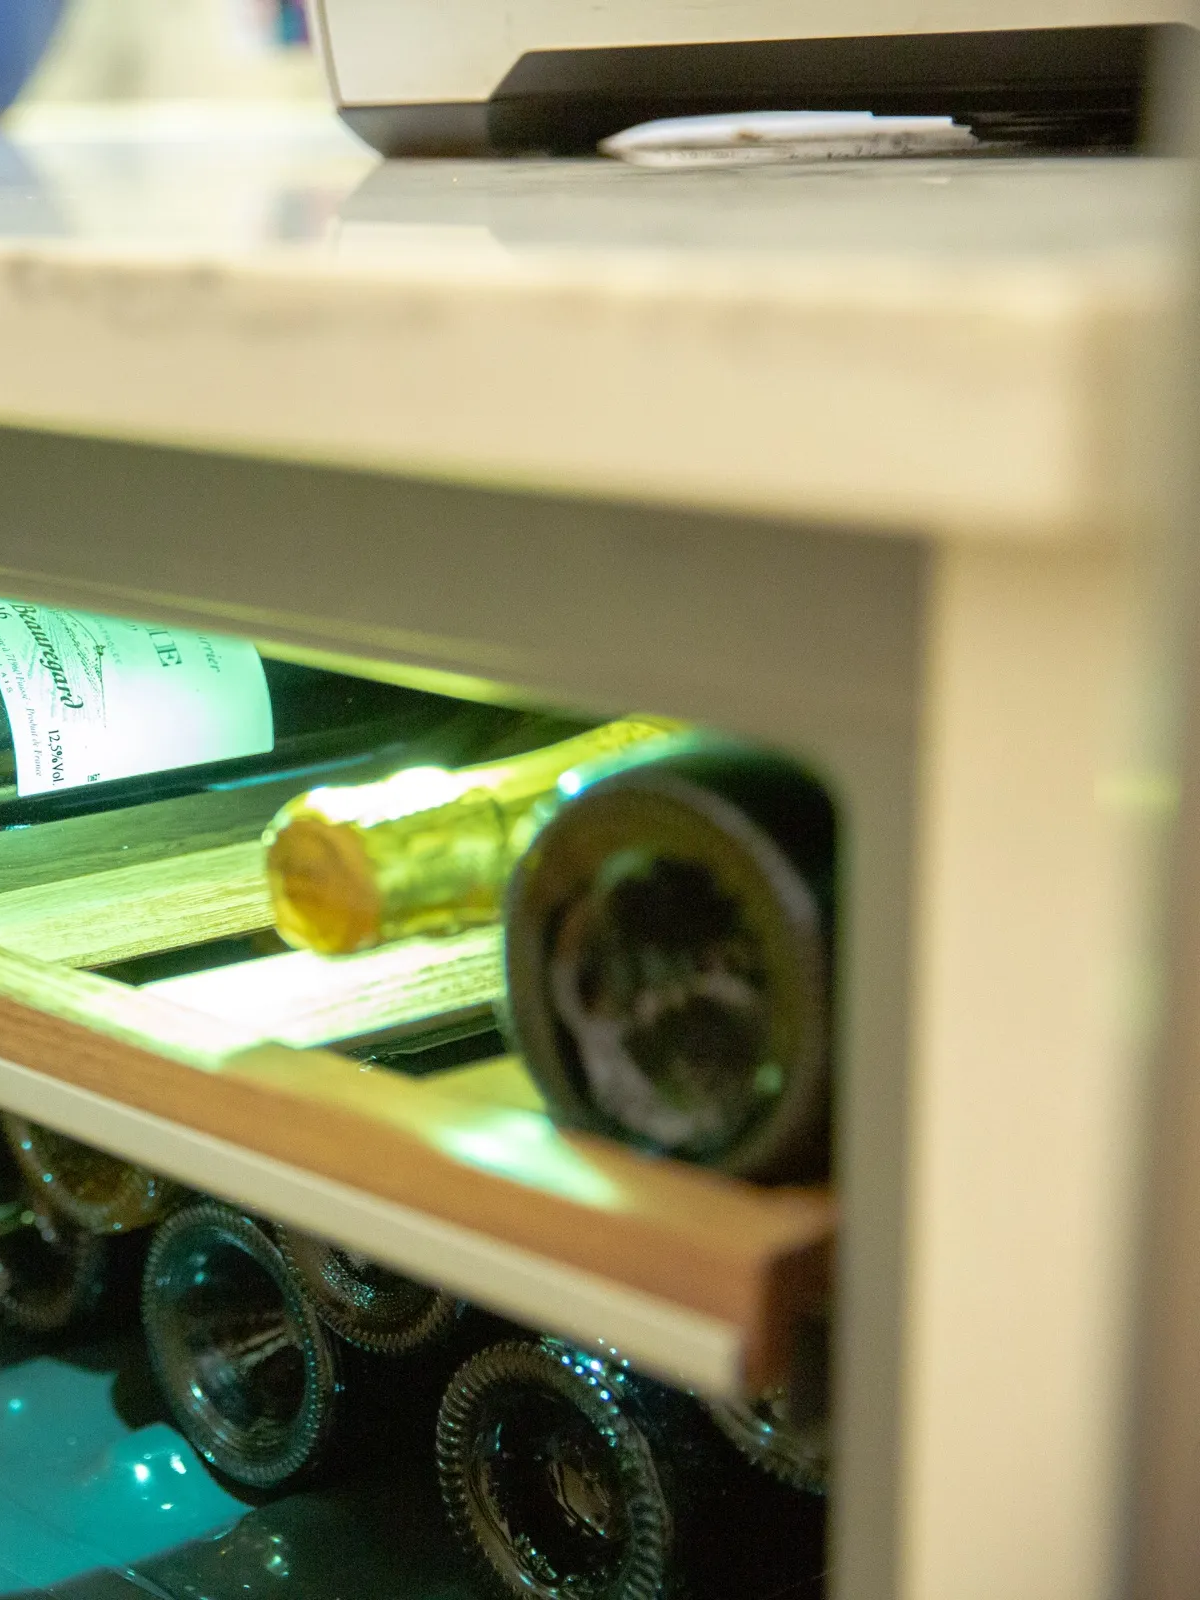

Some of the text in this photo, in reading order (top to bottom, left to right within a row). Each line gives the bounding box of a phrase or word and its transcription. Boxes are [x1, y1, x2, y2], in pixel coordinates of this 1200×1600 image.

[8, 602, 85, 709] Beauregard
[26, 707, 39, 738] Produit
[34, 749, 43, 777] France
